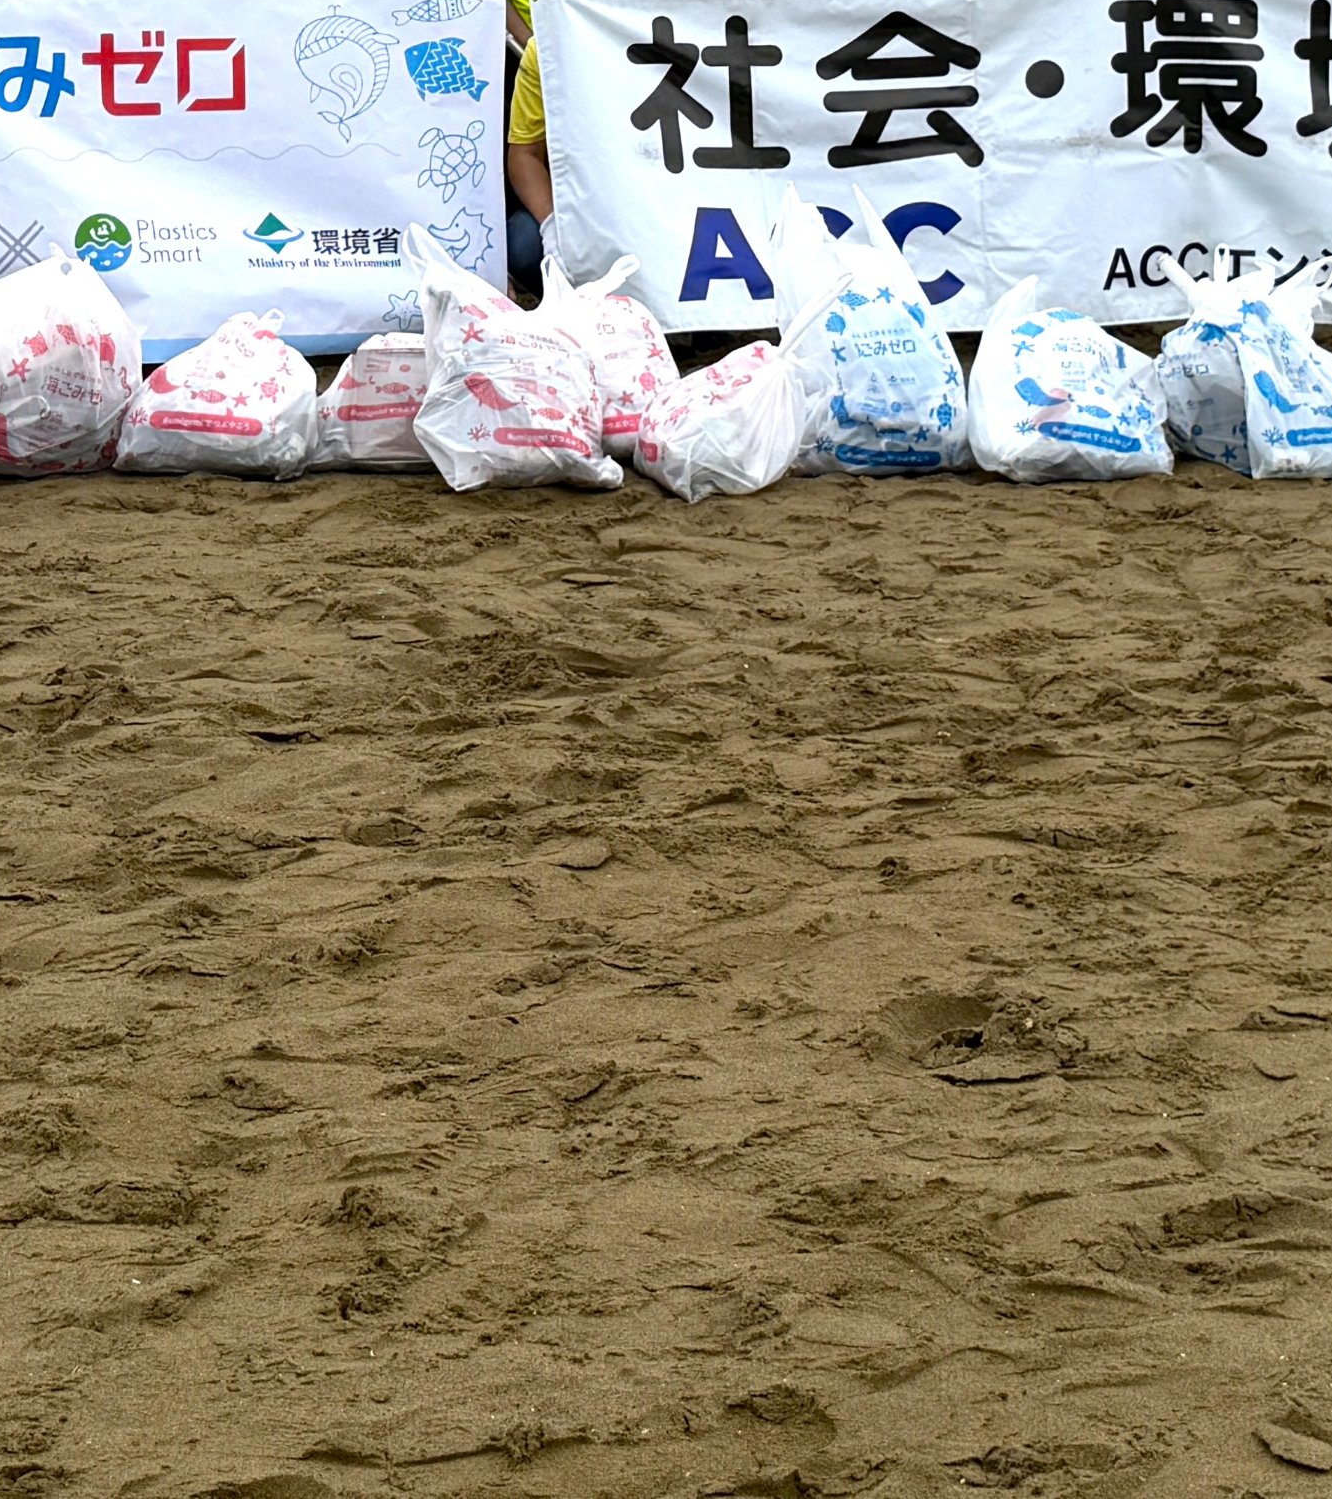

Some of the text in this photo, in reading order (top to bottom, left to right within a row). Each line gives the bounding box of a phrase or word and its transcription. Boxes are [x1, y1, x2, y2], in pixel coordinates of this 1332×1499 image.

[136, 219, 218, 241] Plastics
[312, 227, 402, 255] 環境省
[139, 241, 202, 264] Smart
[248, 258, 402, 270] Ministry of the Environment
[678, 201, 966, 306] AC
